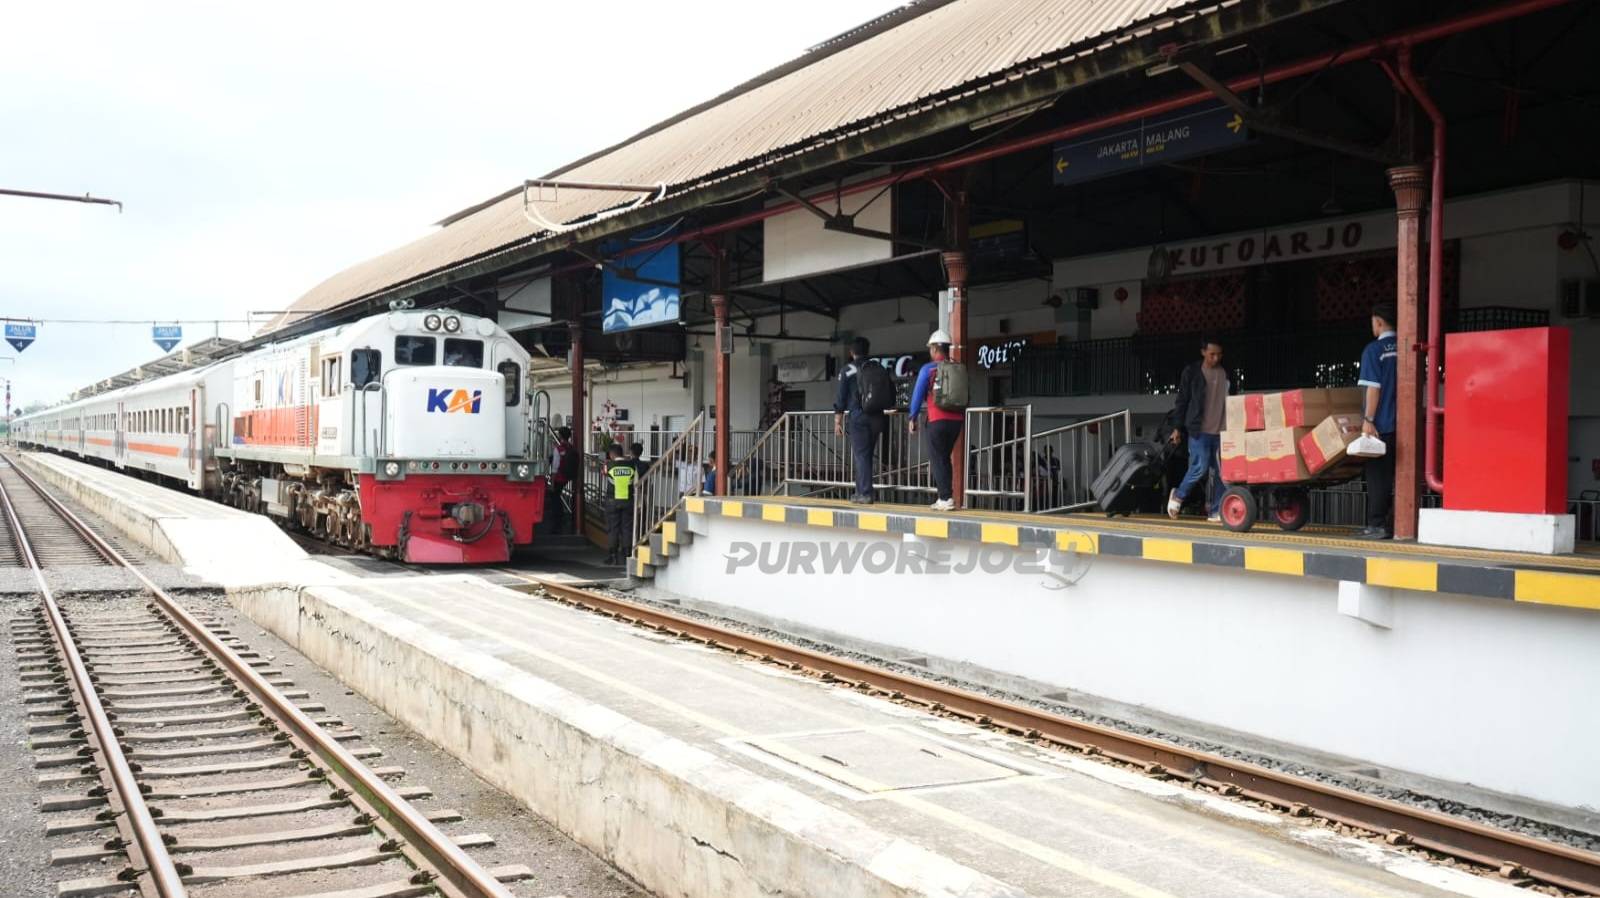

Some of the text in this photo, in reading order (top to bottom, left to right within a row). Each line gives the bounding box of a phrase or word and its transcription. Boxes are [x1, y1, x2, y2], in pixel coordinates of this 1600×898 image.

[1145, 125, 1190, 146] MALANG
[1096, 138, 1138, 159] JAKARTA
[1167, 221, 1362, 270] KUTOARJO
[426, 388, 482, 414] KAI
